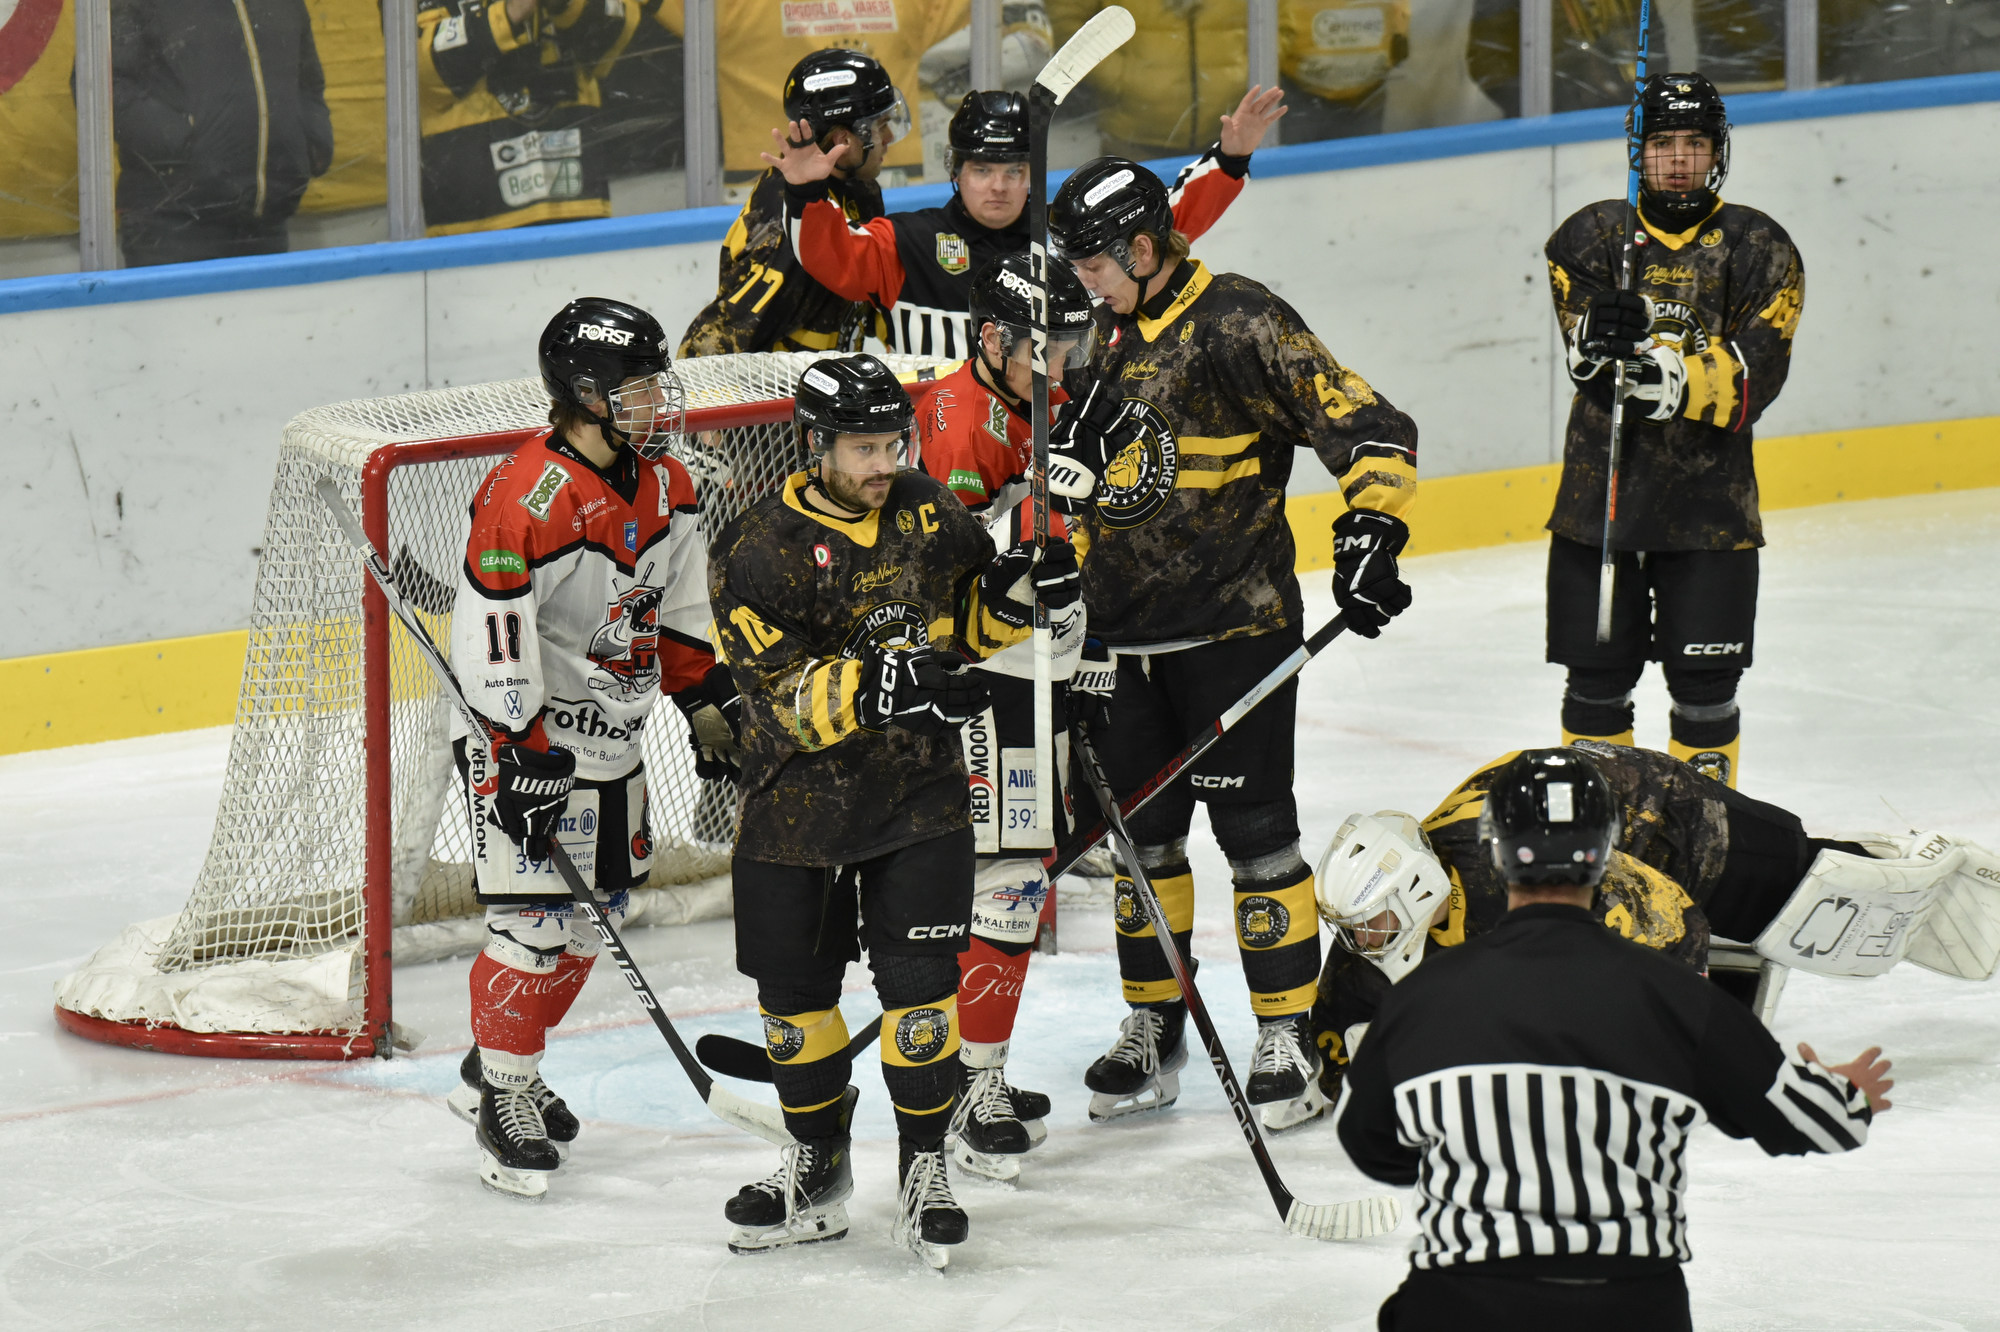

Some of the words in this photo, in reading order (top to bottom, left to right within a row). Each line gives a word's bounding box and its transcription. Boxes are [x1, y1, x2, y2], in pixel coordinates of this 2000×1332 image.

[824, 106, 852, 117] CCM
[1668, 102, 1701, 110] CCM
[1119, 205, 1145, 225] CCM
[728, 263, 784, 314] 77
[997, 269, 1032, 299] FORS
[1031, 241, 1047, 376] CCM
[1064, 310, 1090, 323] FORST
[1655, 303, 1691, 320] CMV
[578, 323, 635, 346] FORST
[800, 408, 817, 420] CCM
[869, 402, 900, 413] CCM
[1157, 430, 1175, 499] HOCKEY
[947, 475, 984, 489] CLEANTE
[1032, 457, 1046, 549] JETSP
[918, 503, 939, 534] C
[865, 605, 906, 632] HCMV
[486, 611, 521, 664] 18
[1683, 642, 1744, 655] CCM
[484, 680, 504, 688] Auto
[878, 648, 899, 716] CCM
[583, 746, 597, 757] for
[969, 715, 989, 777] MOON
[472, 747, 486, 784] RED
[1190, 774, 1245, 788] CCM
[971, 786, 990, 823] RED
[473, 792, 487, 859] MOON
[1918, 834, 1950, 860] CCM
[907, 924, 966, 940] CCM
[984, 916, 1031, 930] KALTERN
[1260, 995, 1288, 1003] HOAX
[908, 1010, 934, 1019] HCMV
